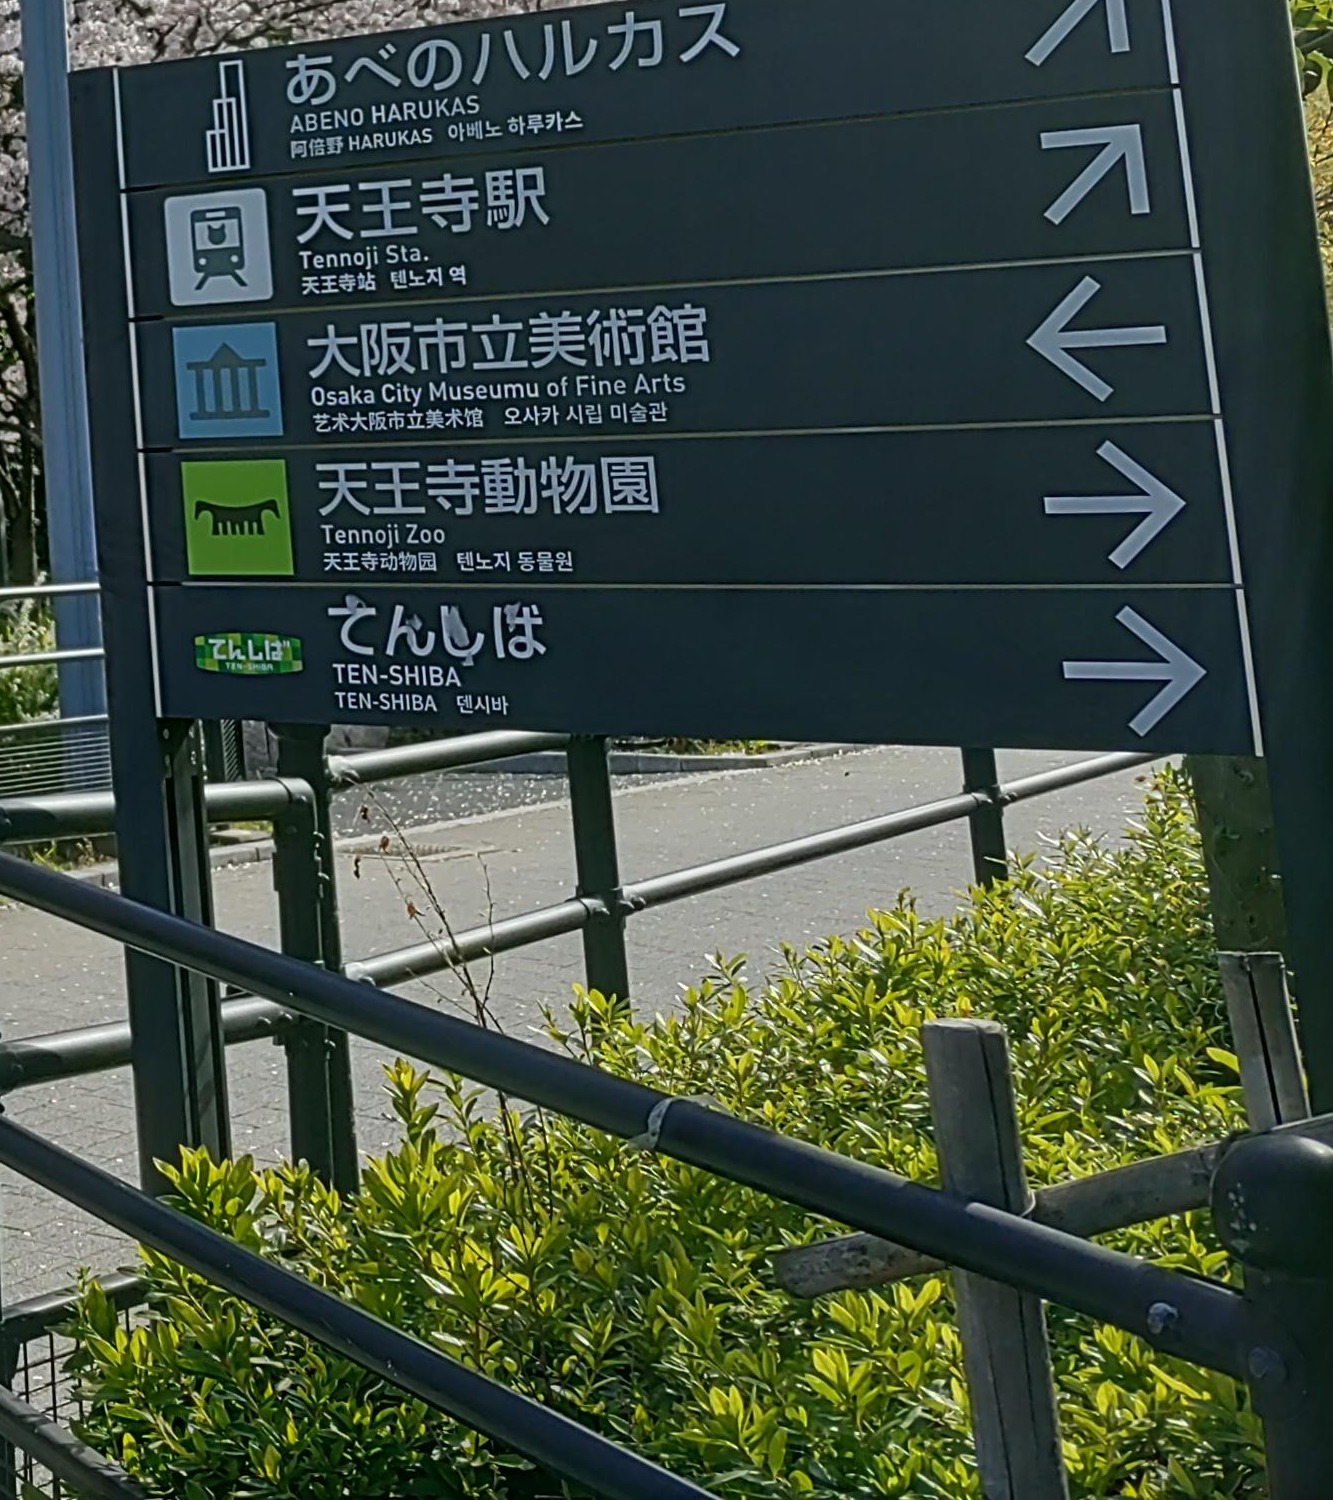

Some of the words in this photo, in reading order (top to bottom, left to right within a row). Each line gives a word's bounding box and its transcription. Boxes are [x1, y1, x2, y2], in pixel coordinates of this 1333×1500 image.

[285, 2, 740, 106] あべのハルカス
[290, 107, 364, 133] ABENO
[371, 95, 480, 124] HARUKAS
[448, 120, 503, 142] 아베노
[507, 110, 583, 136] 하루카스
[290, 136, 343, 159] 阿倍野
[348, 128, 433, 151] HARUKAS
[292, 167, 550, 244] 天王寺駅
[299, 246, 378, 270] Tennoji
[386, 245, 429, 264] Sta.
[301, 272, 376, 295] 天王寺站
[390, 266, 442, 290] 텐노지
[449, 265, 467, 286] 역
[307, 303, 710, 379] 大阪市立美術館
[311, 386, 375, 407] Osaka
[381, 382, 421, 408] City
[429, 378, 539, 402] Museumu
[547, 376, 568, 397] of
[576, 375, 626, 397] Fine
[634, 373, 685, 395] Arts
[312, 407, 484, 432] 艺术大阪市立美术馆
[504, 405, 559, 426] 오사카
[566, 403, 603, 424] 시립
[610, 401, 668, 423] 미술관
[315, 455, 659, 516] 天王寺動物園
[320, 524, 399, 549] Tennoji
[406, 524, 446, 544] Zoo
[323, 552, 437, 571] 天王寺动物园
[456, 551, 510, 572] 텐노지
[517, 551, 573, 572] 동물원
[328, 598, 547, 660] てんしば
[208, 639, 290, 661] てんしば
[333, 664, 461, 687] TEN-SHIBA
[335, 692, 437, 713] TEN-SHIBA
[457, 694, 509, 716] 덴시바
